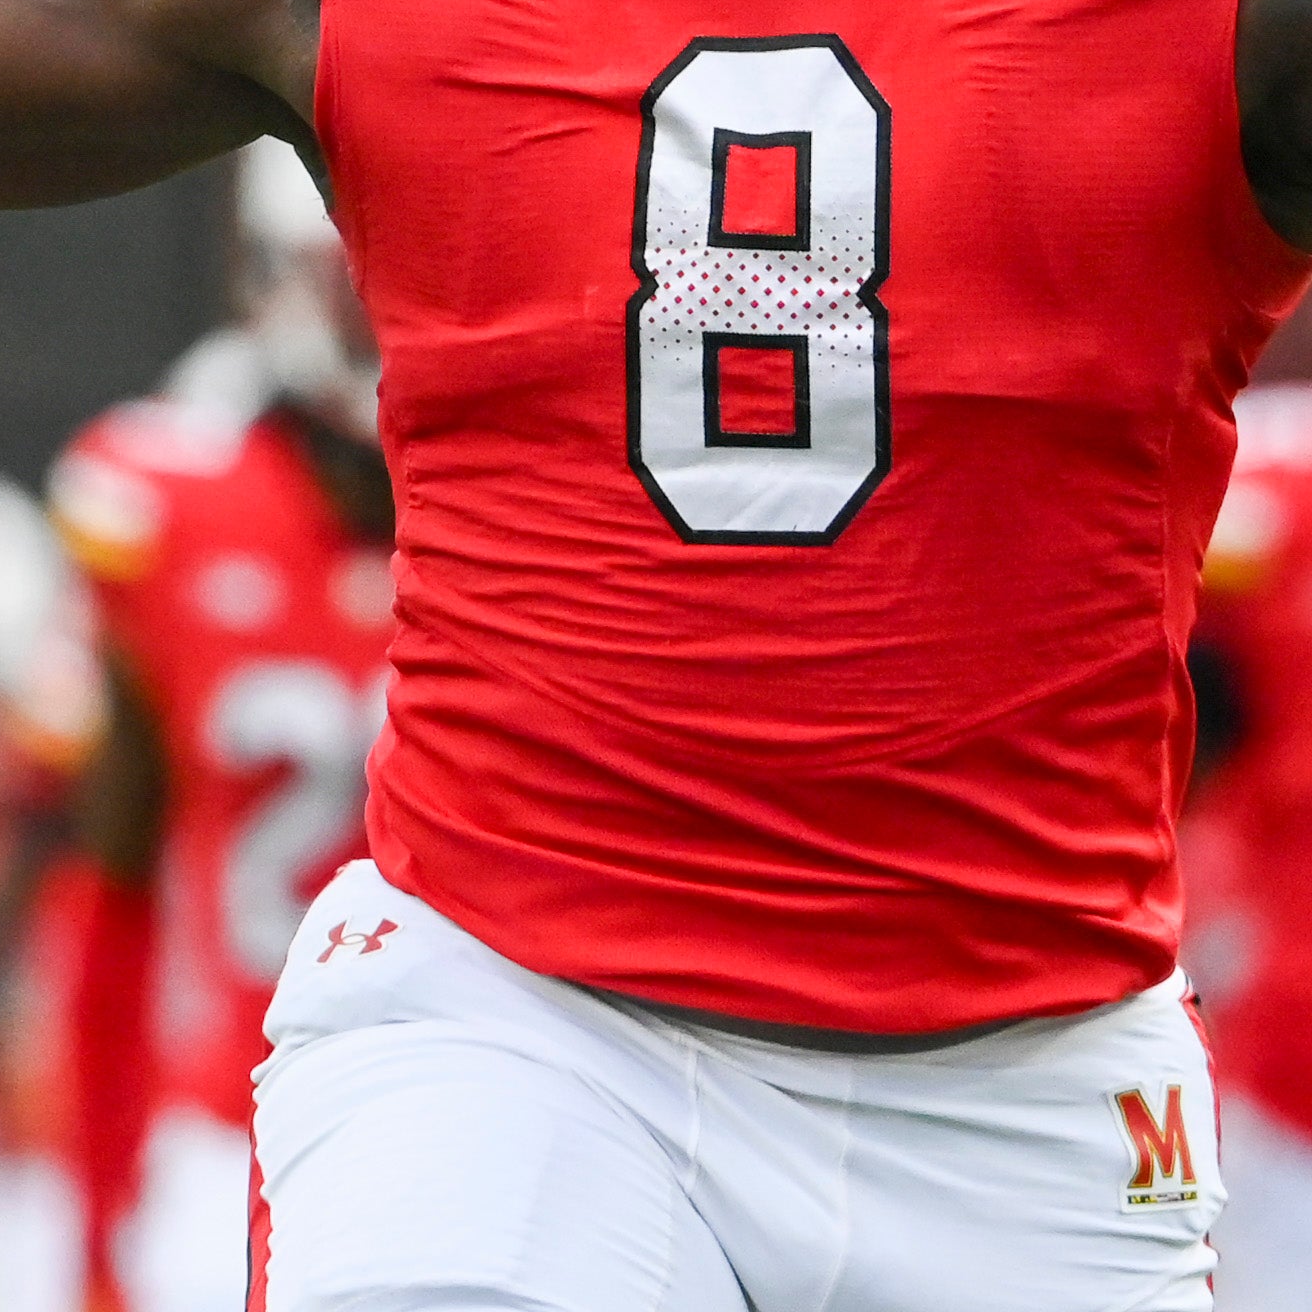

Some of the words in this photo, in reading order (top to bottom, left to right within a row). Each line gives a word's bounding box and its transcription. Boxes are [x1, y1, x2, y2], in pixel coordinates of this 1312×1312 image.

[625, 33, 892, 547] 8
[200, 658, 388, 980] 2
[1114, 1084, 1197, 1189] M
